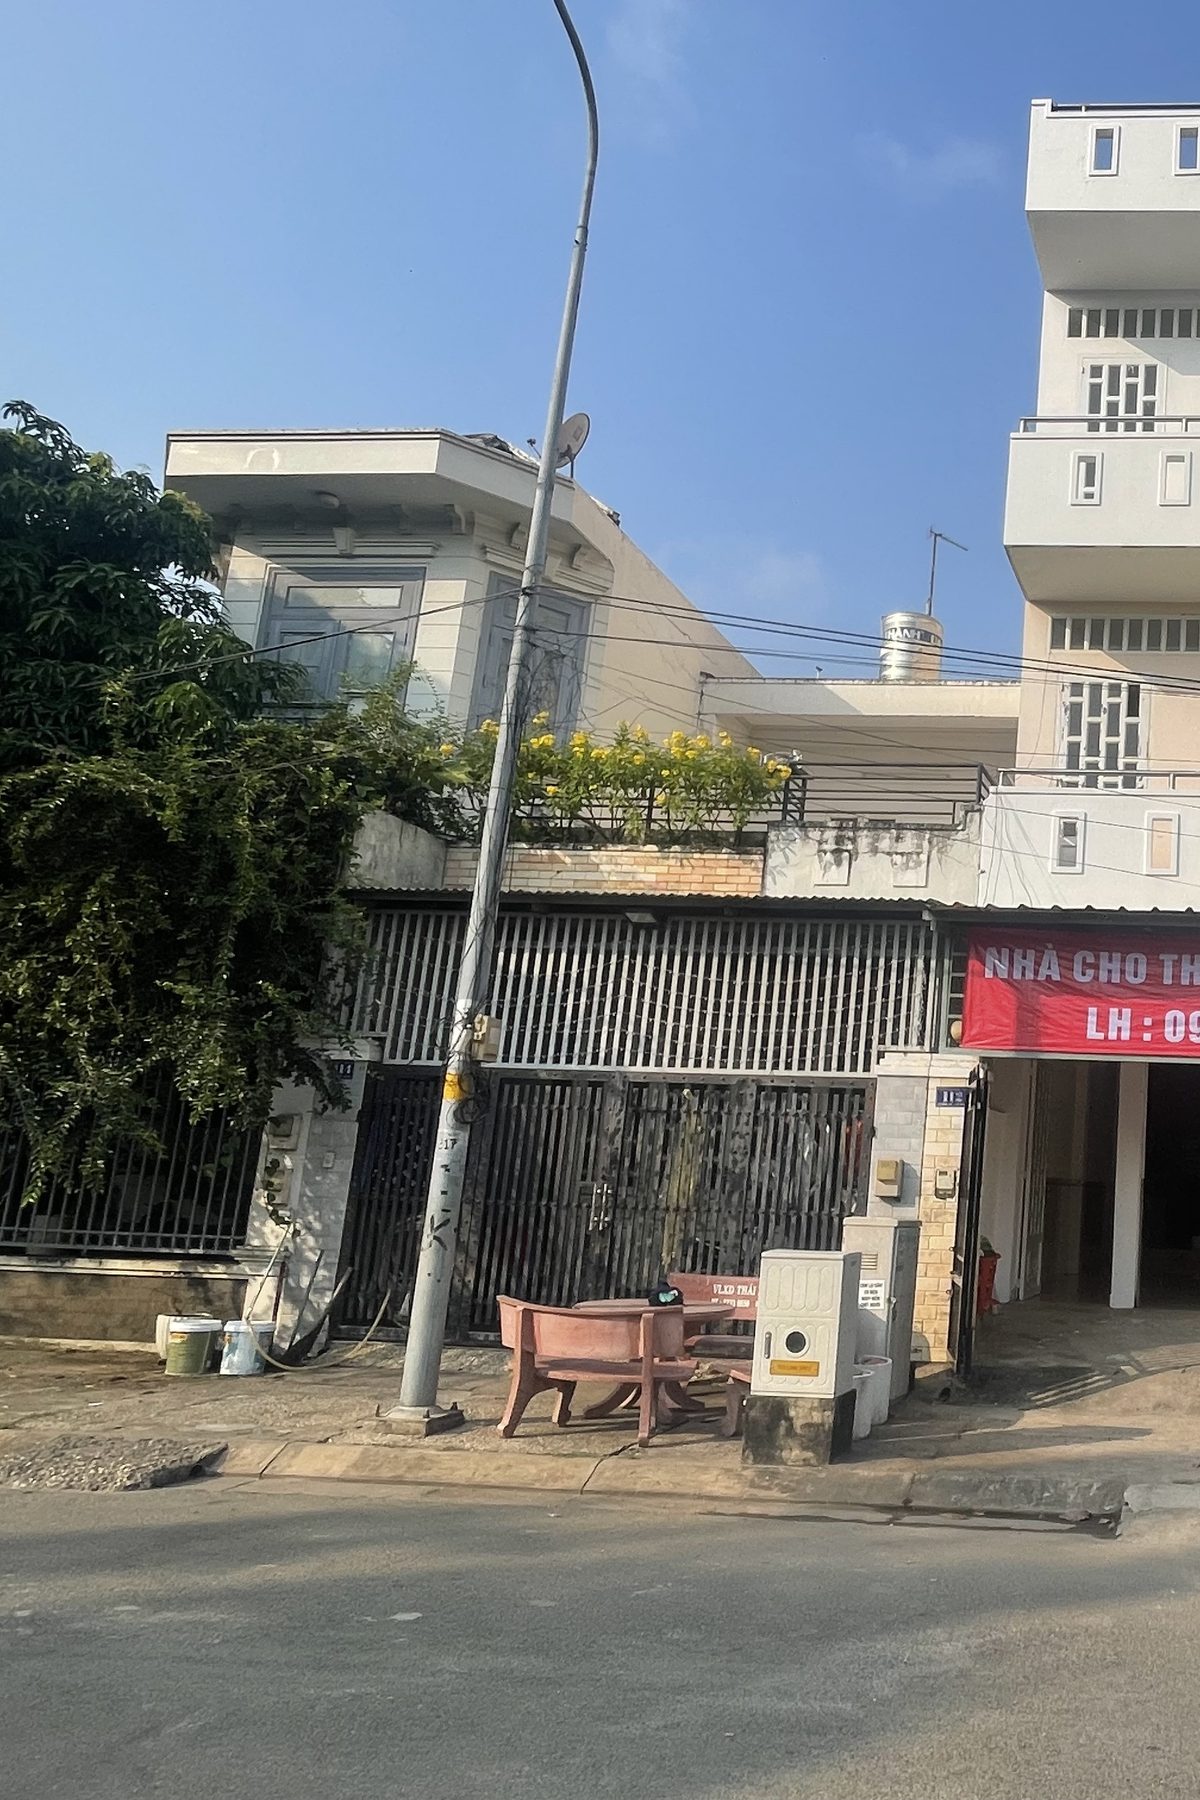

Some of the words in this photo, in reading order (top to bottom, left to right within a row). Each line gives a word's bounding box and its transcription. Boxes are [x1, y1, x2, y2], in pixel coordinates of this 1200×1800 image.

[984, 943, 1061, 981] NHÀ
[1073, 951, 1148, 985] CHO
[1086, 1007, 1132, 1041] LH
